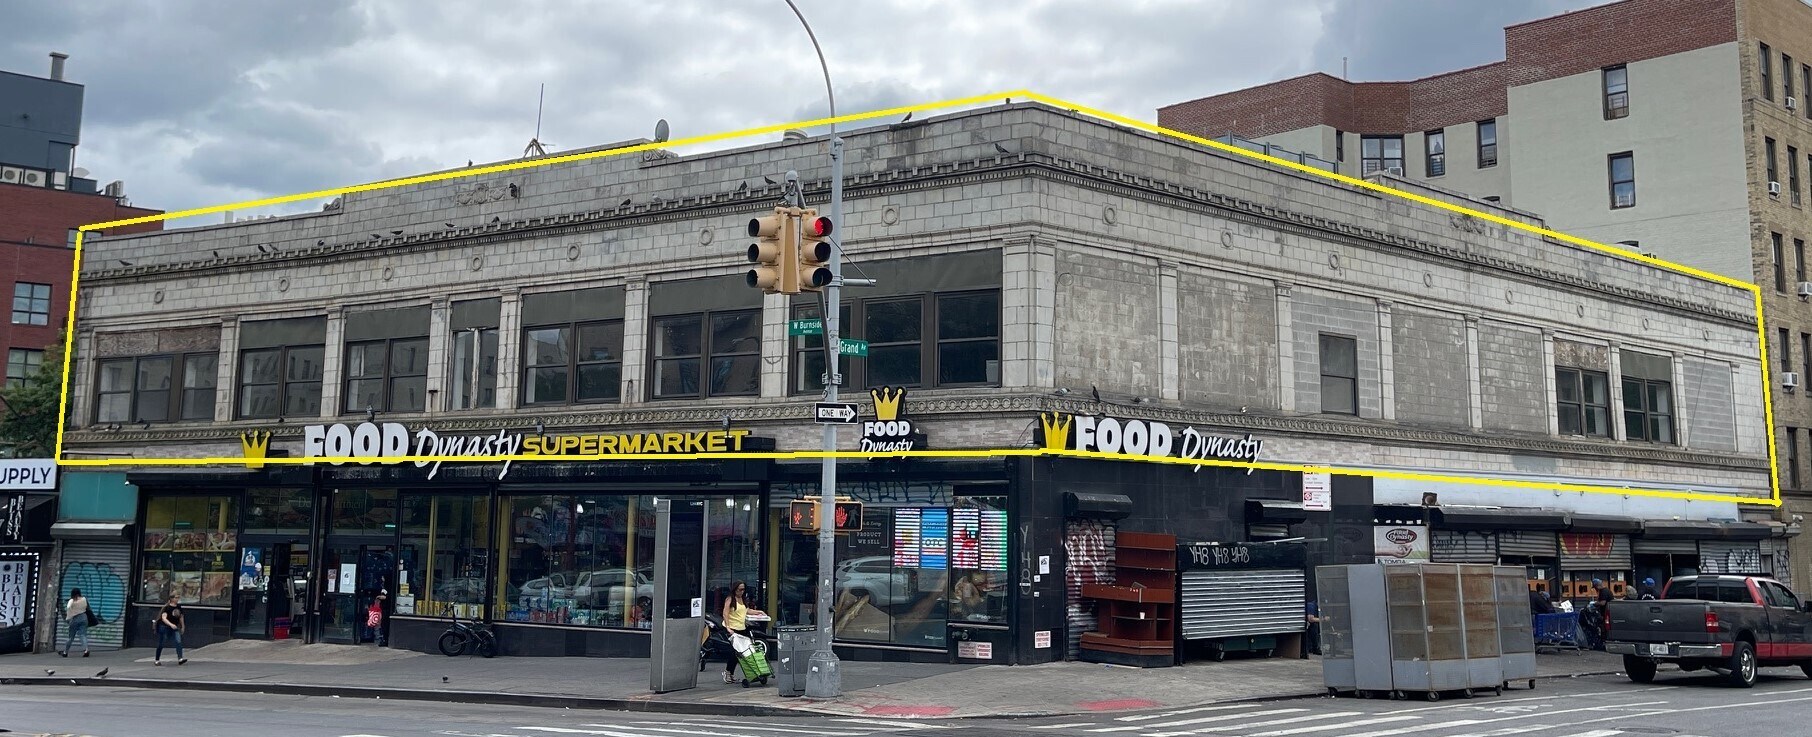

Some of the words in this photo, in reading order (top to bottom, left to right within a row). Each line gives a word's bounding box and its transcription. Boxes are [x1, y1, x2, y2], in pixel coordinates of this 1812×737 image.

[799, 321, 822, 329] Burnside
[840, 341, 859, 354] Grand
[821, 409, 834, 417] ONE
[839, 409, 852, 417] WAY
[864, 421, 911, 436] FOOD
[304, 422, 409, 466] FOOD
[415, 427, 521, 480] Dynasty
[522, 430, 749, 456] SUPERMARKET
[860, 438, 914, 461] Dynasty
[1075, 415, 1173, 458] FOOD
[1181, 426, 1264, 475] Dynasty
[13, 495, 24, 540] BEAUTY
[0, 574, 11, 620] BLISS
[10, 563, 24, 626] BEAUTY
